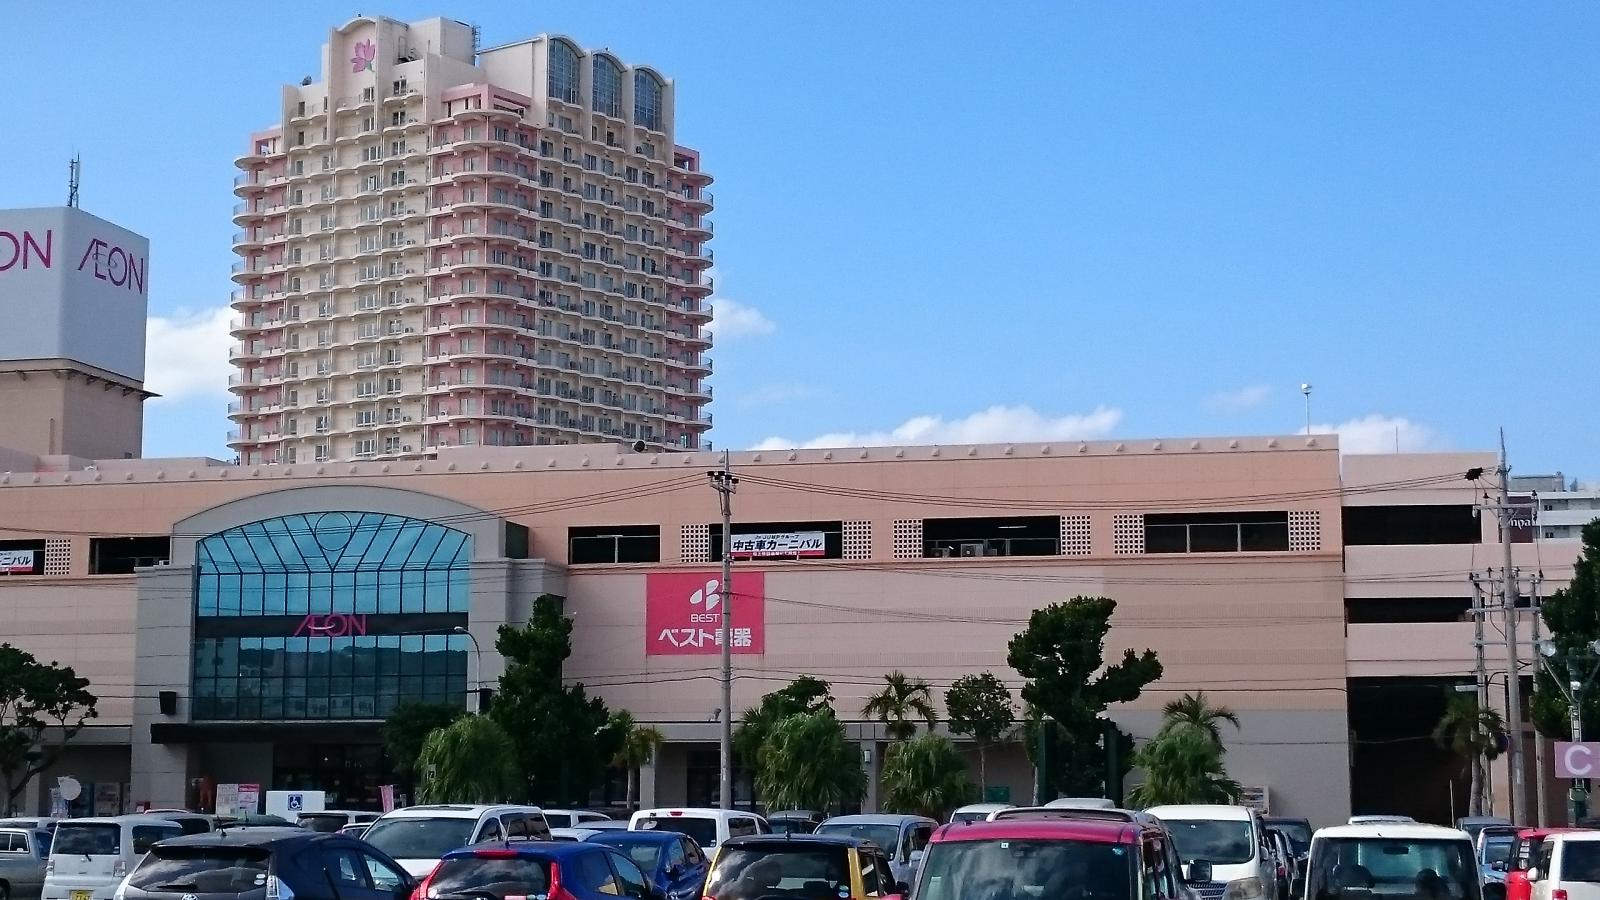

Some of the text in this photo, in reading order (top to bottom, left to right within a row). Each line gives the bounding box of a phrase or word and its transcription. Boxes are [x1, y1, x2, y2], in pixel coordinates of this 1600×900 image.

[732, 538, 823, 551] 中古車カーニバル
[0, 556, 32, 566] ニバル
[690, 613, 721, 623] BEST
[1564, 744, 1592, 776] C
